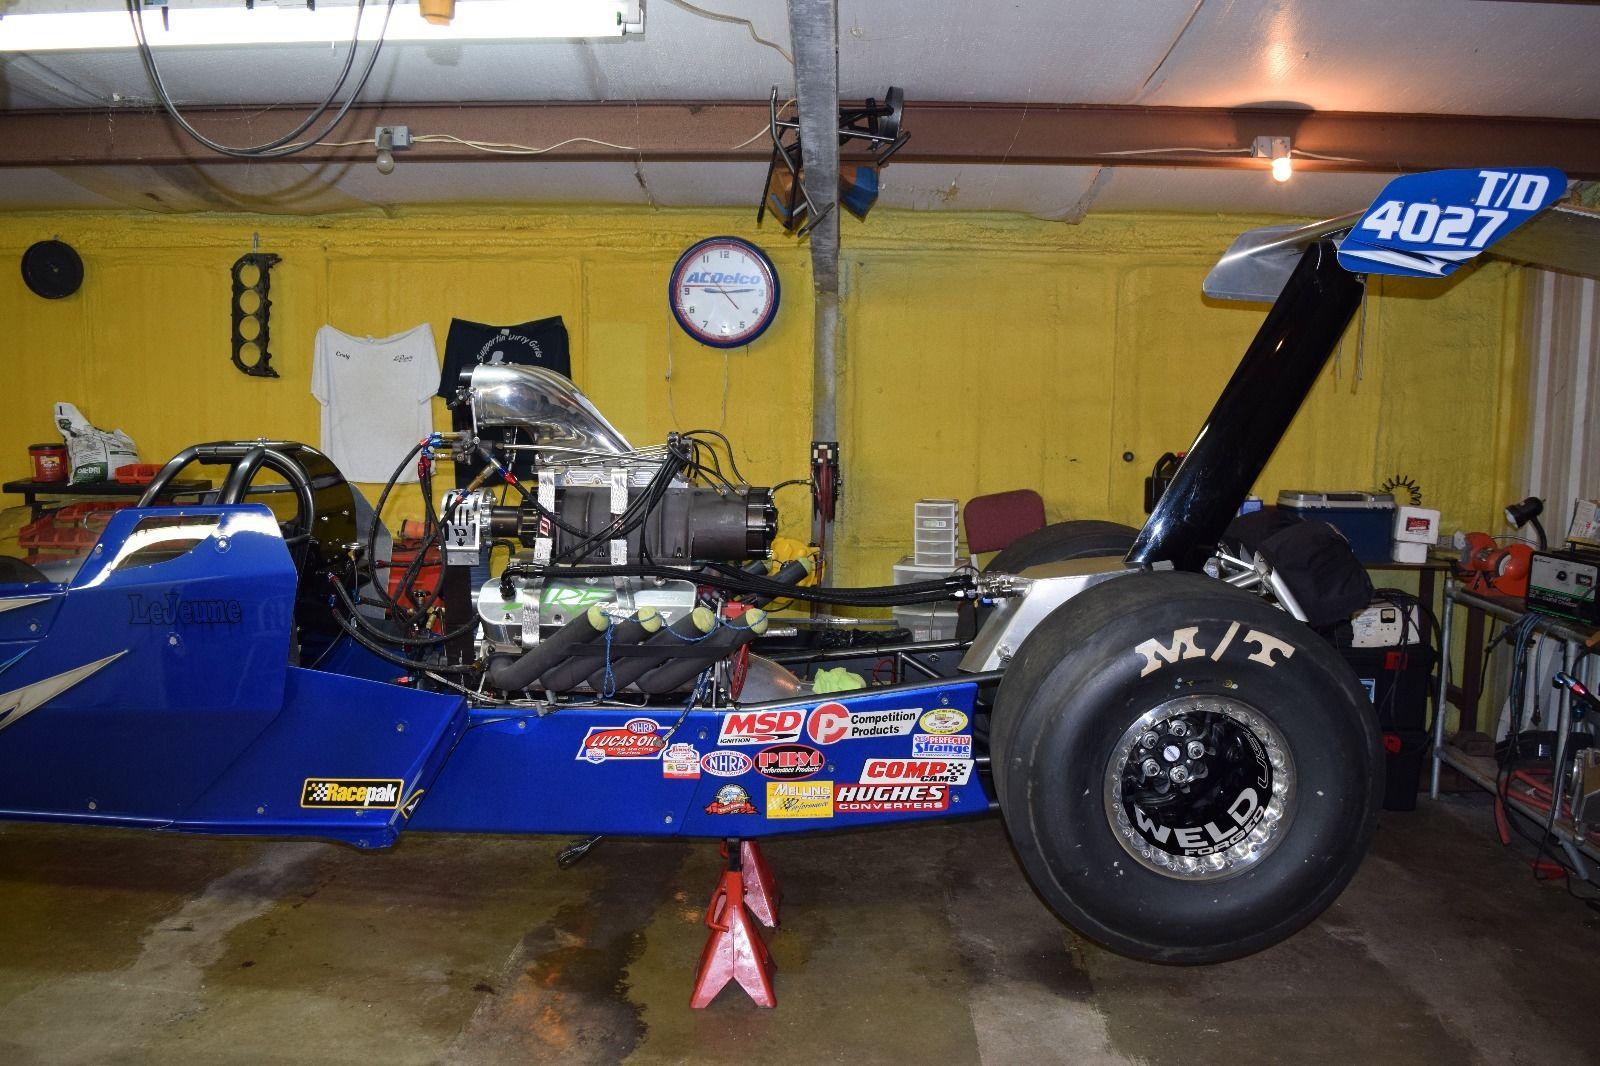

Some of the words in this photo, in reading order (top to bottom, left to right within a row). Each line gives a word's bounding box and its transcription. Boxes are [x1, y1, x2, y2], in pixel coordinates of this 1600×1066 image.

[1474, 170, 1550, 211] T/D
[1361, 200, 1509, 248] 4027
[719, 250, 730, 259] 12
[686, 271, 763, 285] ACDelco
[684, 287, 690, 296] 9
[702, 320, 708, 329] 7
[127, 593, 242, 625] LeJeune
[1134, 620, 1296, 678] M/T
[724, 711, 802, 735] MSD
[850, 711, 916, 725] Competition
[631, 722, 654, 733] NHRA
[851, 725, 900, 737] Products
[591, 735, 637, 747] LUCAS
[929, 736, 969, 745] PERFECTLY
[914, 743, 970, 754] Strange
[709, 755, 745, 772] NHRA
[760, 766, 795, 774] Performance
[867, 761, 948, 779] COMP
[920, 775, 959, 783] CAMS
[326, 783, 398, 807] Racepak
[836, 785, 946, 802] HUGHES
[838, 802, 943, 810] CONVERTERS
[1133, 787, 1258, 848] WELD
[1184, 805, 1265, 856] FORGED
